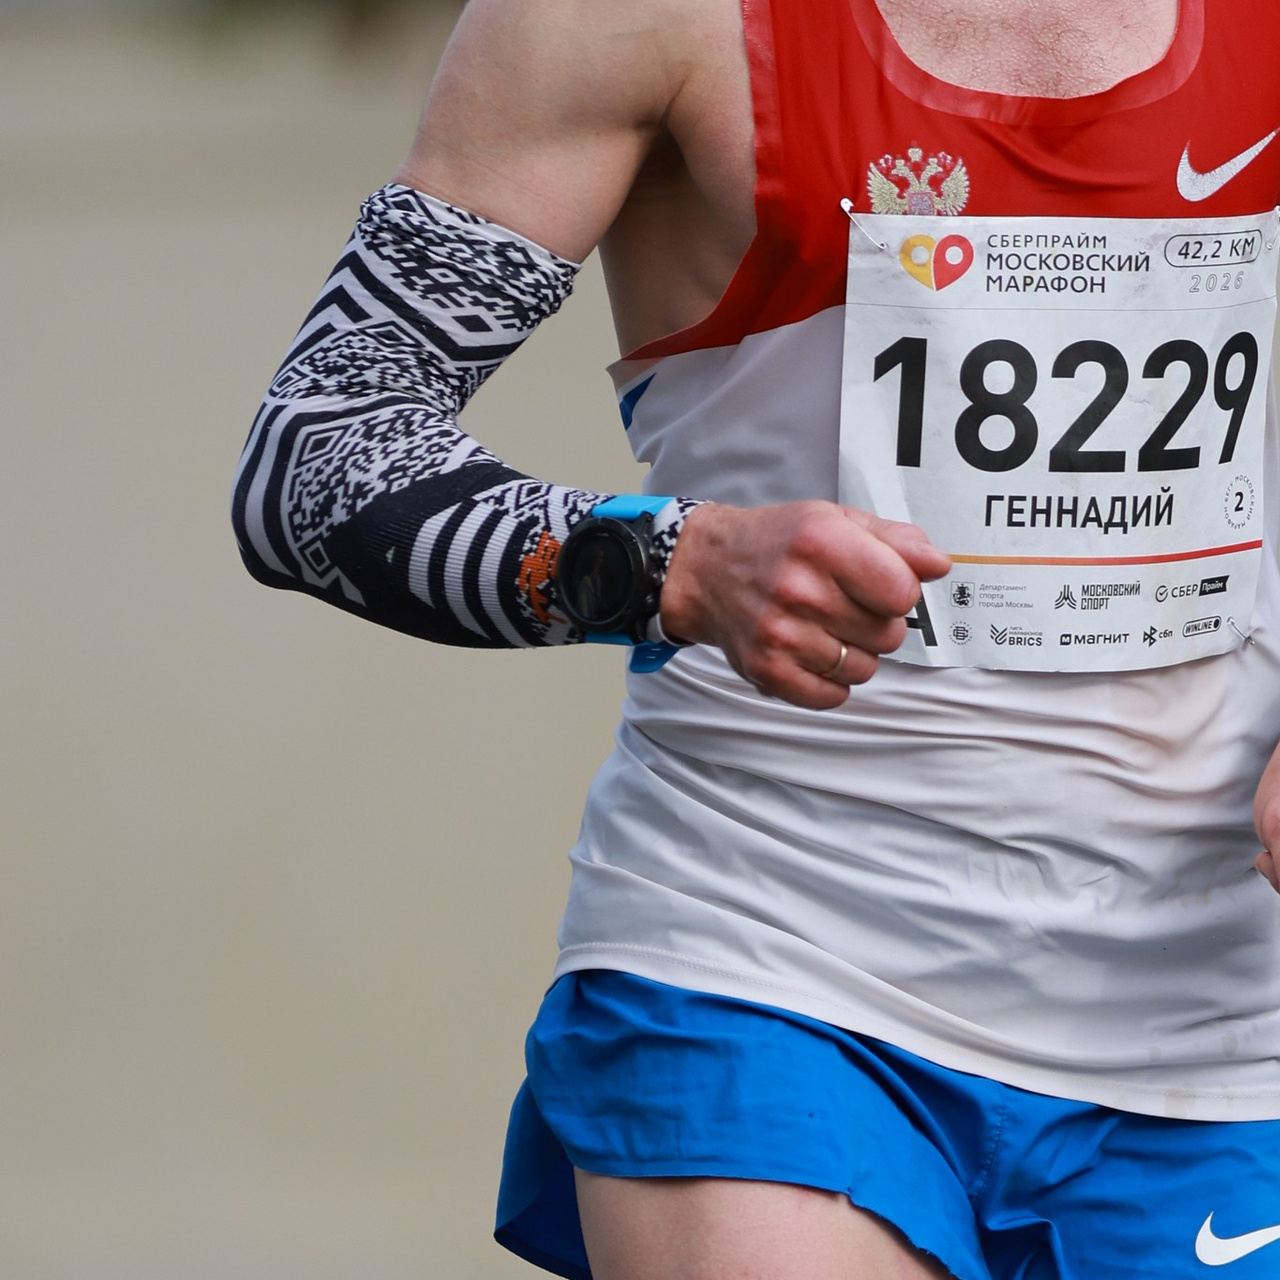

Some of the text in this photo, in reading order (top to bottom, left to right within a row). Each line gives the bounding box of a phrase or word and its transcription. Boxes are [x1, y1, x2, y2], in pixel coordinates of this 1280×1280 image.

[987, 232, 1107, 249] СБЕРПРАЙМ
[1177, 237, 1255, 262] 42,2 КМ
[986, 251, 1150, 272] МОСКОВСКИЙ
[985, 275, 1106, 293] МАРАФОН
[1189, 271, 1244, 293] 2026
[873, 331, 1259, 473] 18229
[1234, 491, 1244, 512] 2
[984, 486, 1175, 535] ГЕННАДИЙ
[979, 583, 1027, 592] Департамент
[1081, 581, 1141, 597] МОСКОВСКИЙ
[1171, 584, 1198, 598] СБЕР
[979, 592, 1004, 600] спорта
[1081, 597, 1110, 610] СПОРТ
[978, 600, 1004, 608] города
[1158, 629, 1173, 639] сбп
[1185, 620, 1213, 634] WINLINE
[1009, 636, 1042, 647] BRICS
[1074, 633, 1130, 645] магнит
